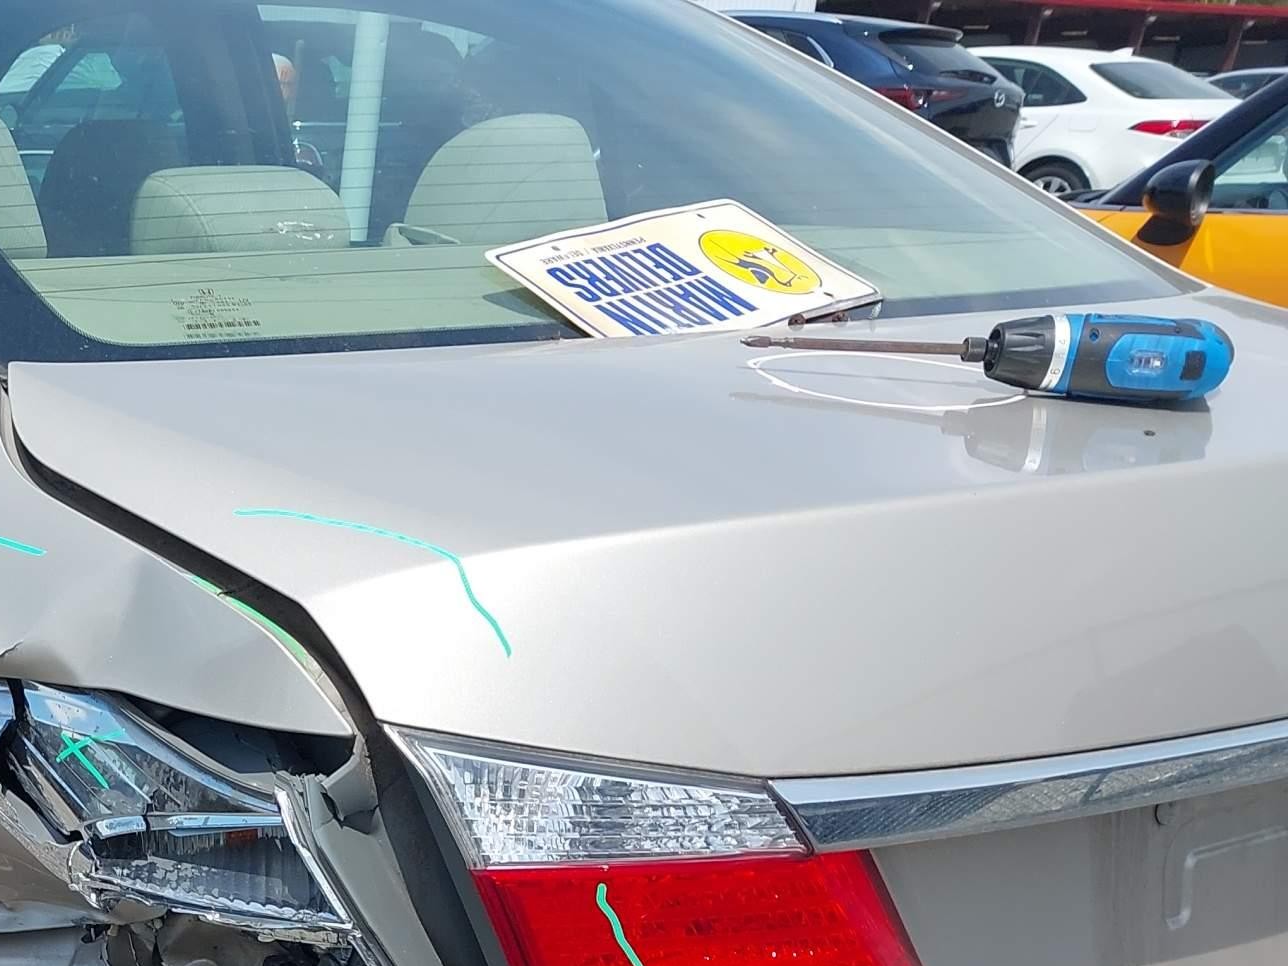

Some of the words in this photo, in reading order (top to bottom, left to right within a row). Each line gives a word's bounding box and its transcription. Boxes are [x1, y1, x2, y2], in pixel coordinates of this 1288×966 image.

[546, 242, 704, 302] DELIVERS
[592, 236, 646, 255] PENNSYLVANIA
[594, 276, 759, 335] MARTIN
